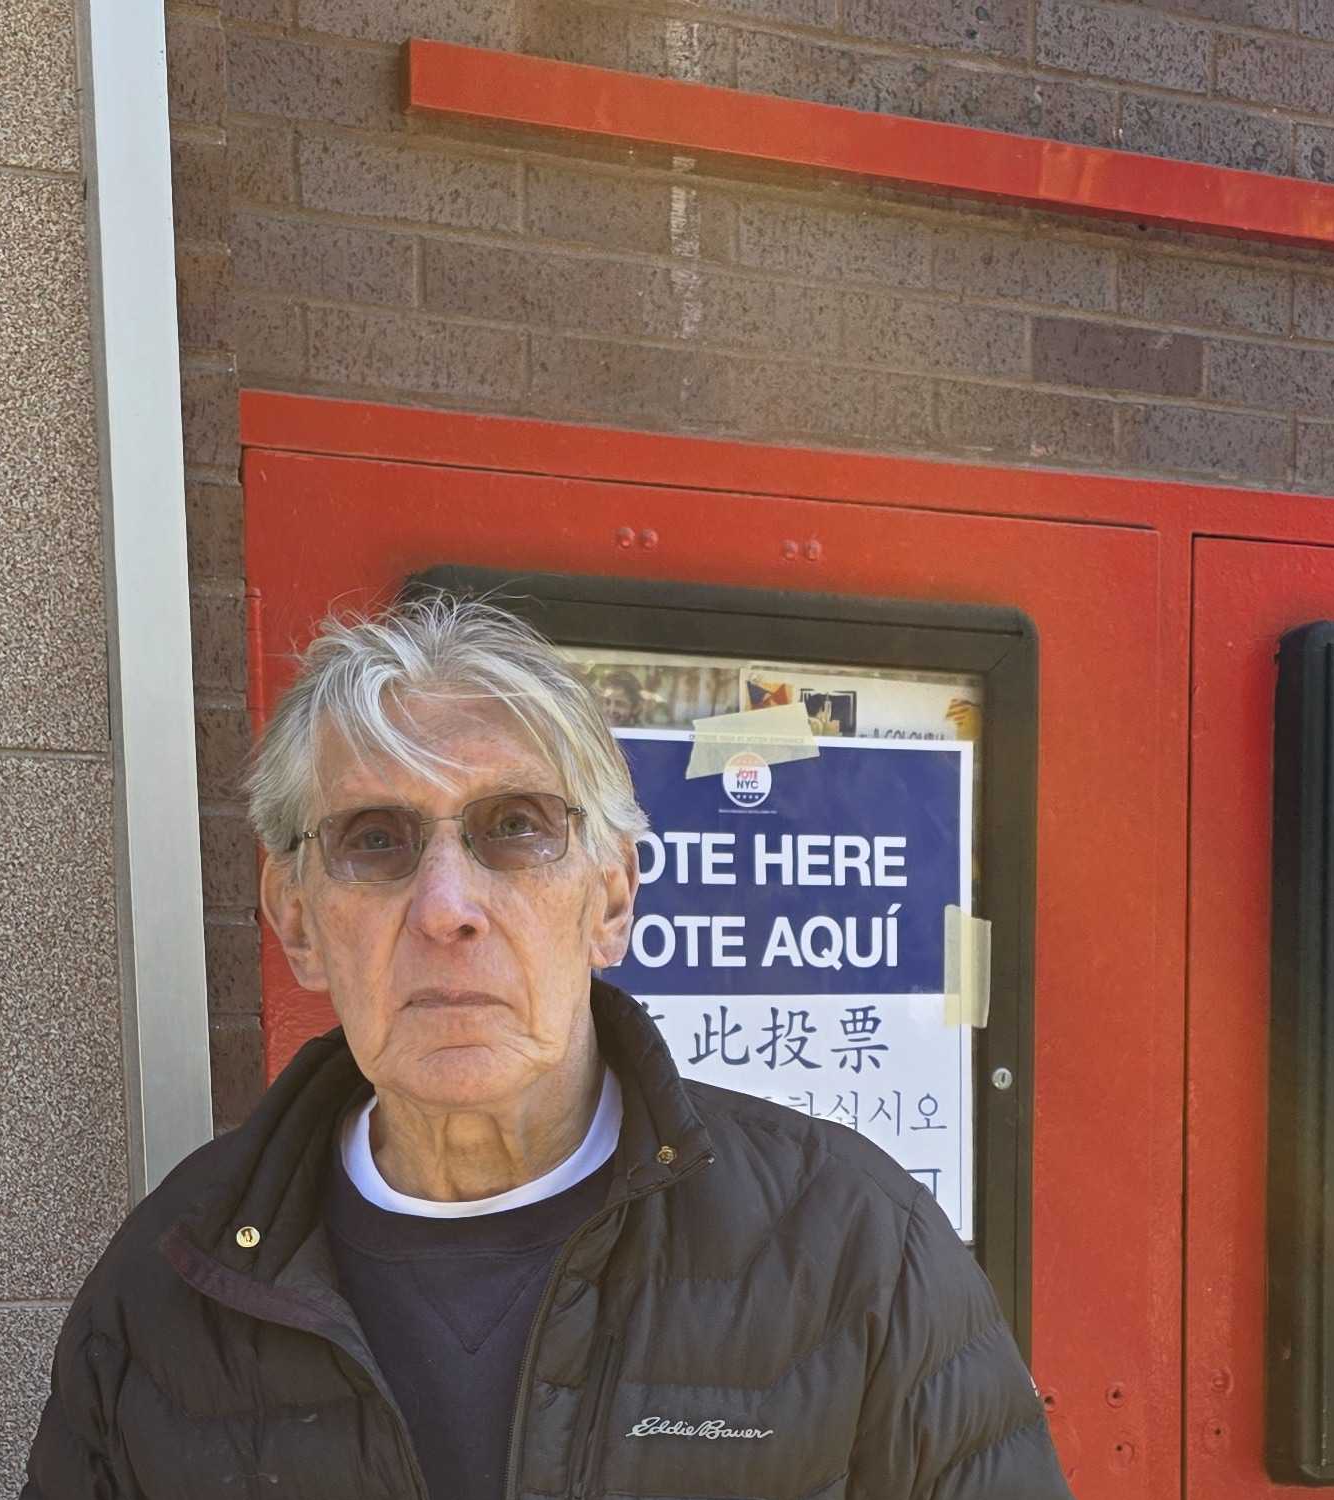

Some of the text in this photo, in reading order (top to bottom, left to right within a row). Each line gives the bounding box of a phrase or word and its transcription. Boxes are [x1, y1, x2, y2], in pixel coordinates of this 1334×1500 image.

[736, 780, 759, 790] NYC
[636, 832, 908, 887] OTE HERE
[614, 904, 899, 971] OTE AQUÍ
[641, 1002, 889, 1073] 此投票
[626, 1417, 774, 1439] Eddie Bauer
